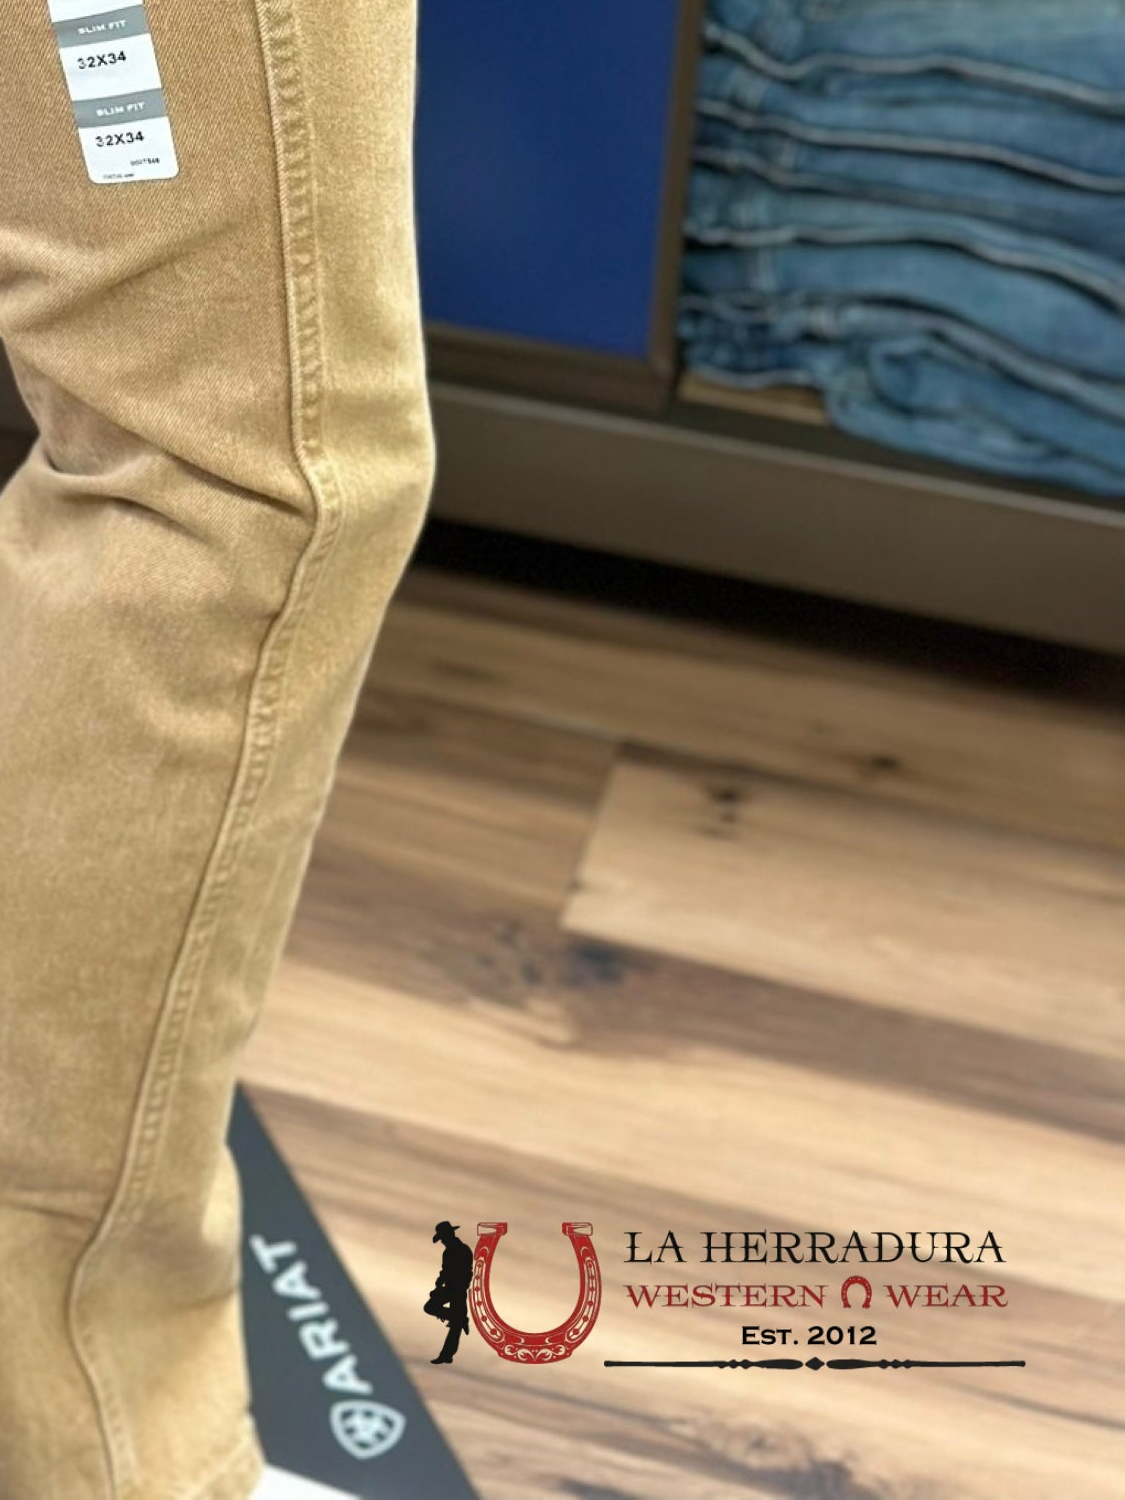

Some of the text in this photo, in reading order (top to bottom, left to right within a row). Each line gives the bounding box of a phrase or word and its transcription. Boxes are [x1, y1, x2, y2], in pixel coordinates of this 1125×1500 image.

[77, 19, 127, 35] SLIM FIT
[77, 51, 127, 70] 32X34
[126, 101, 146, 112] FIT
[95, 130, 145, 148] 32X34
[248, 1234, 374, 1396] ARIAT
